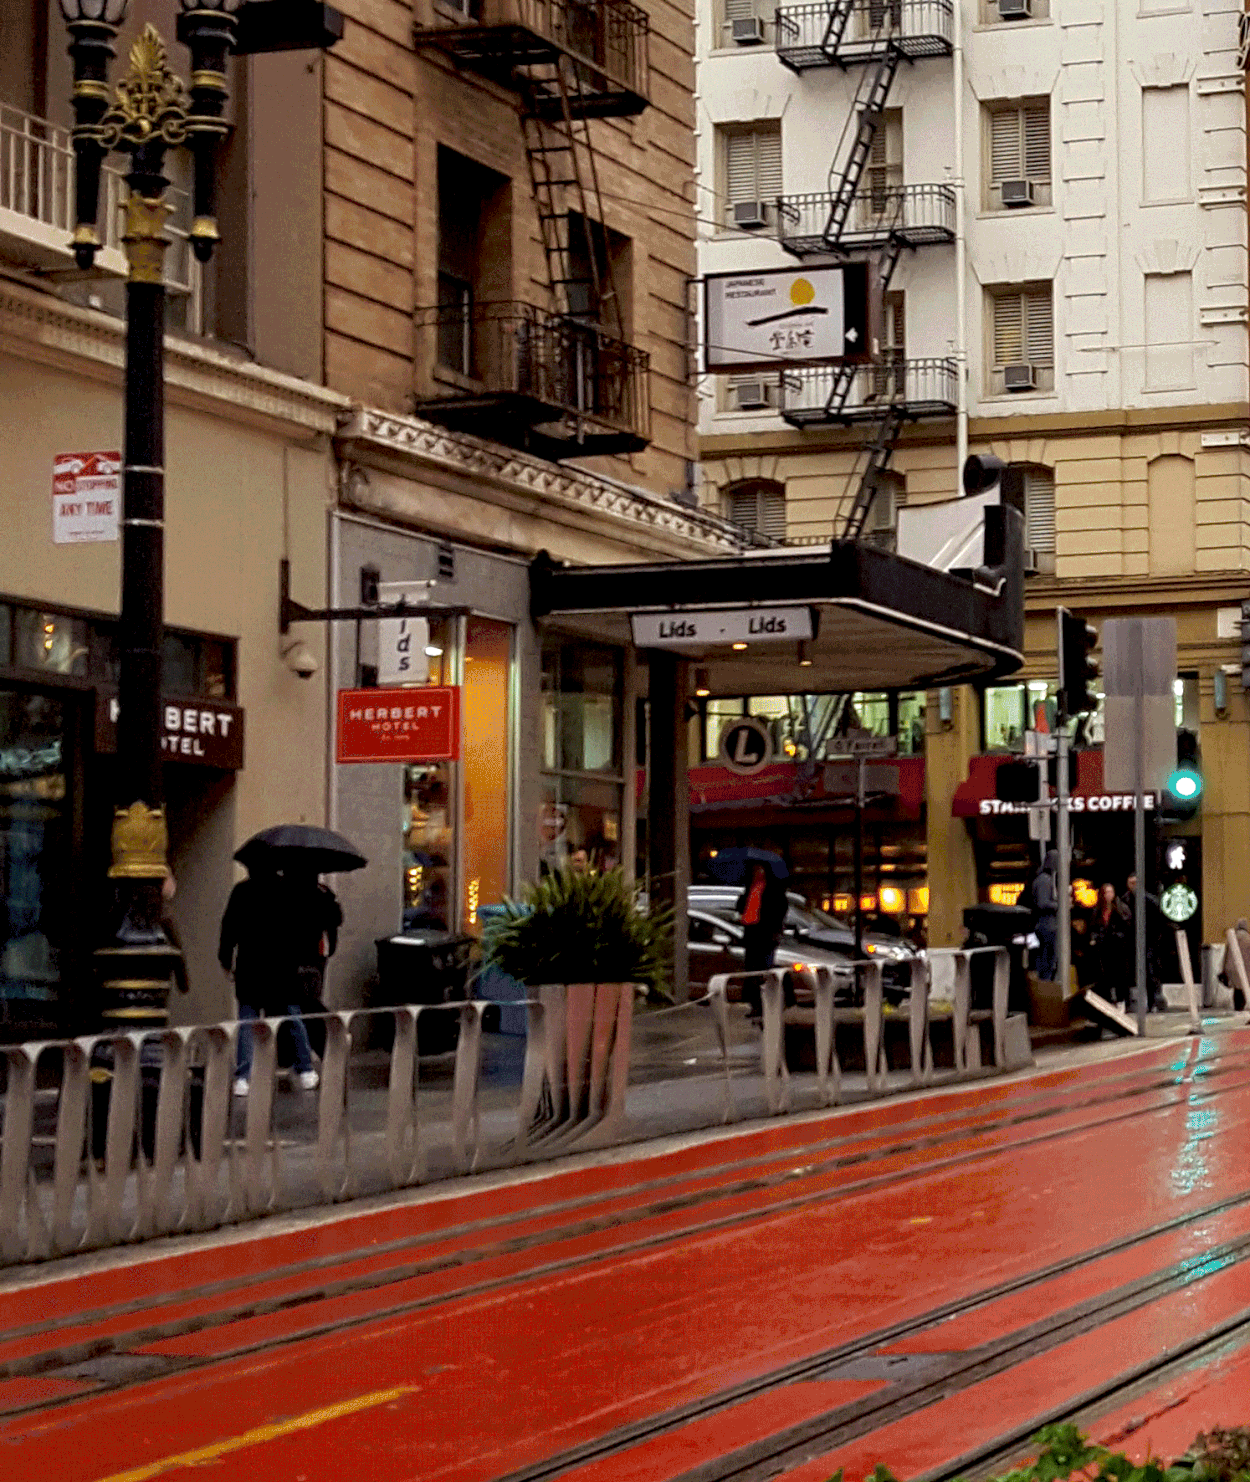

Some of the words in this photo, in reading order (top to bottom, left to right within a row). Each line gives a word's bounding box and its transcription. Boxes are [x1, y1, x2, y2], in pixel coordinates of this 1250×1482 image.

[658, 620, 698, 639] Lids
[748, 615, 787, 635] Lids
[349, 705, 443, 721] HERBERT
[371, 721, 420, 732] HOTEL
